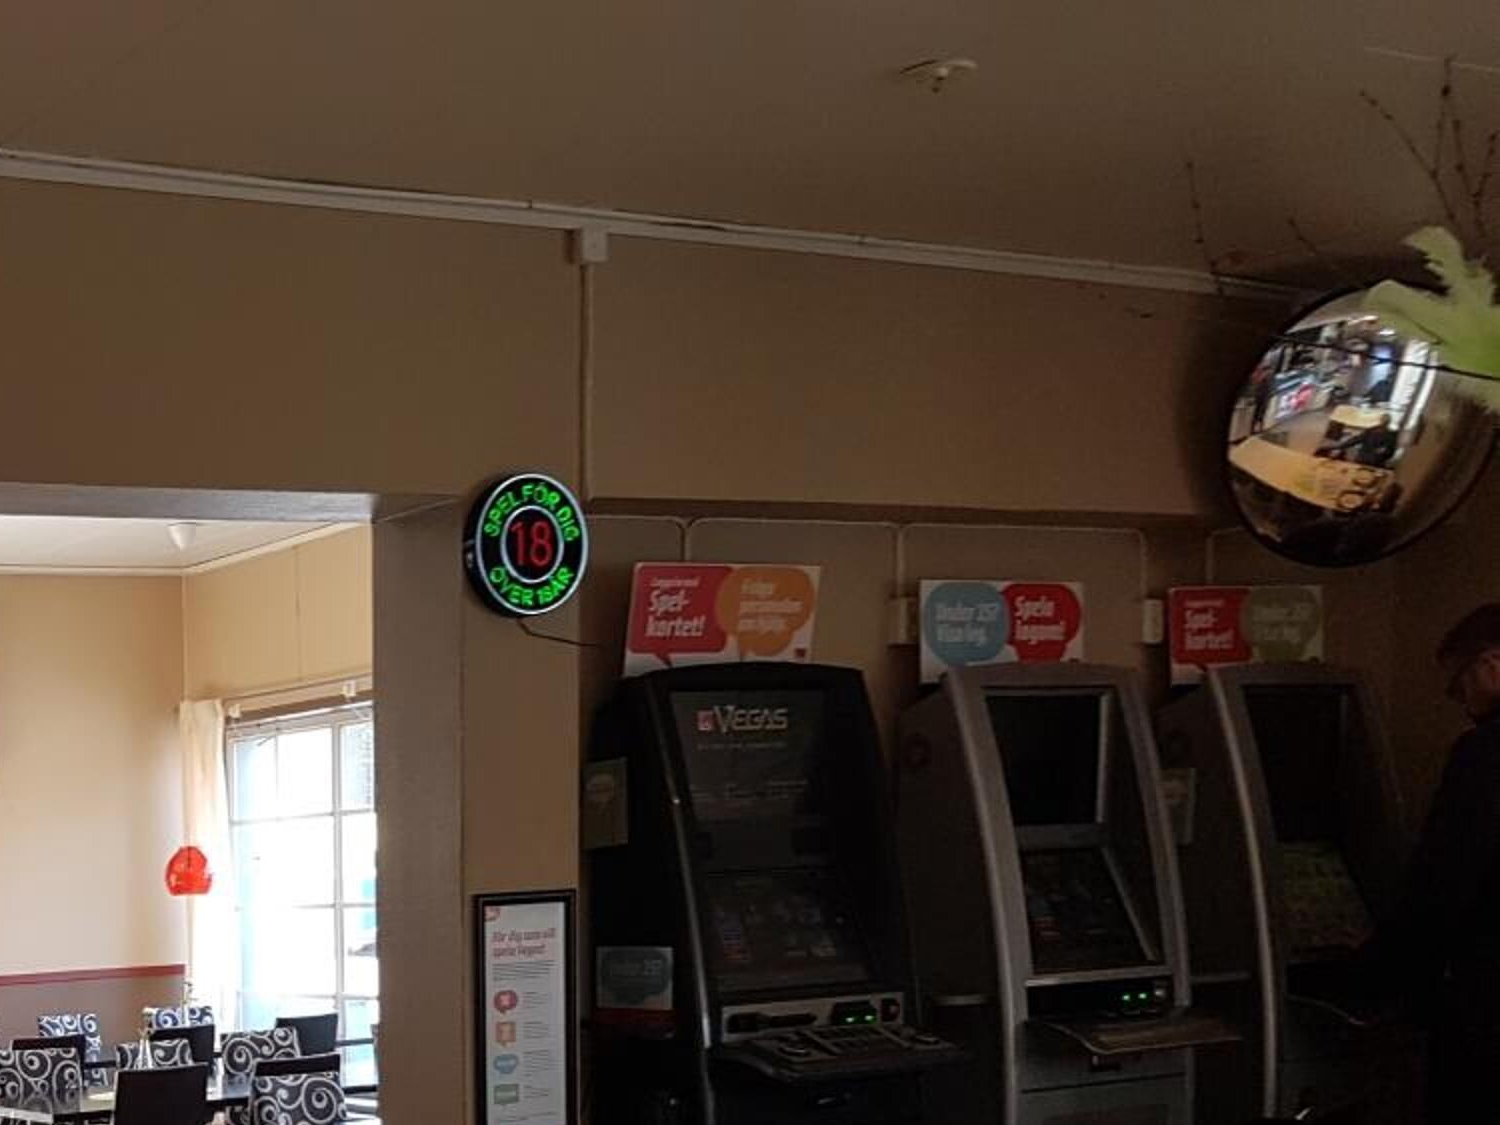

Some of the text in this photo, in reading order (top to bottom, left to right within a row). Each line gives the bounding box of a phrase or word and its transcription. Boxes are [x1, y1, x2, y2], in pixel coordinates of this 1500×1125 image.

[484, 491, 521, 537] SPEL
[555, 505, 580, 541] DIG
[509, 520, 553, 567] 18
[713, 704, 788, 733] VEGAS
